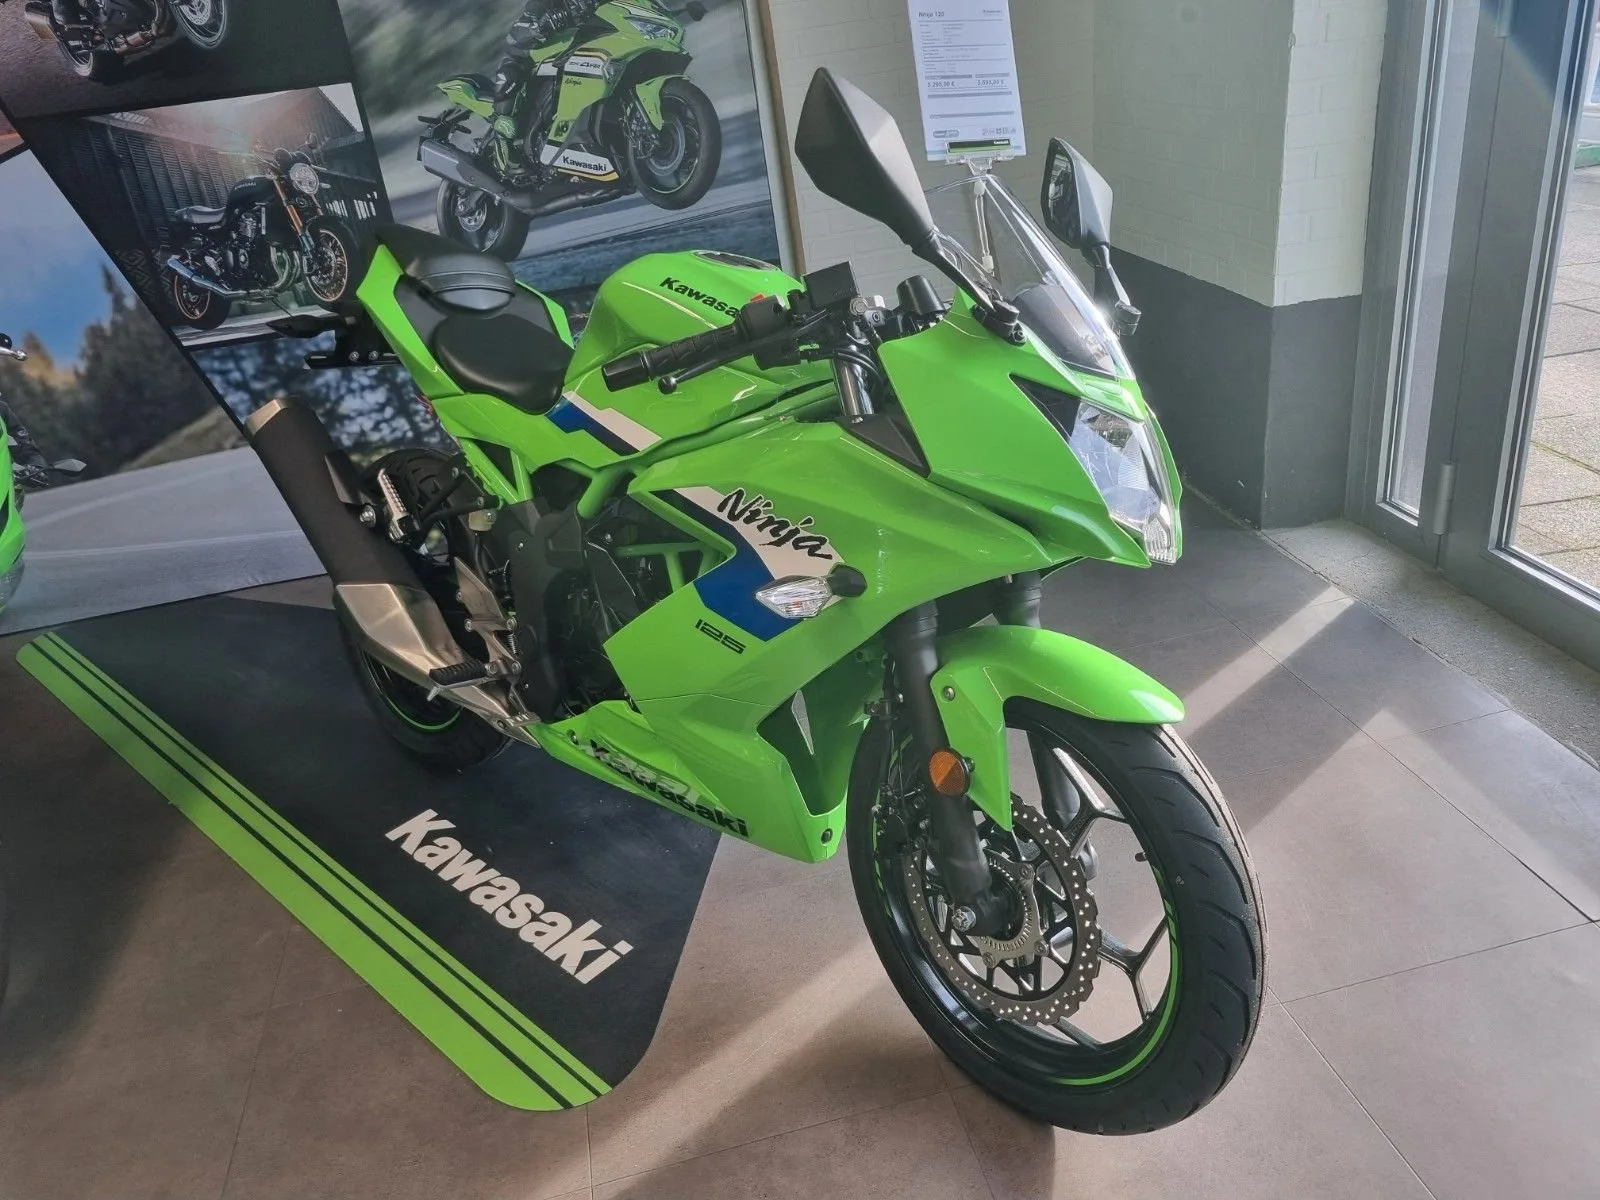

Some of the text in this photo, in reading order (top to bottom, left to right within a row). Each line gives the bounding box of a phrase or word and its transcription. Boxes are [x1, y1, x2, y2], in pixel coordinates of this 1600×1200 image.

[562, 156, 607, 172] Kawasaki
[660, 277, 740, 318] Kawasa
[716, 488, 833, 560] Ninja
[694, 618, 746, 655] 125
[384, 808, 634, 985] Kawasaki
